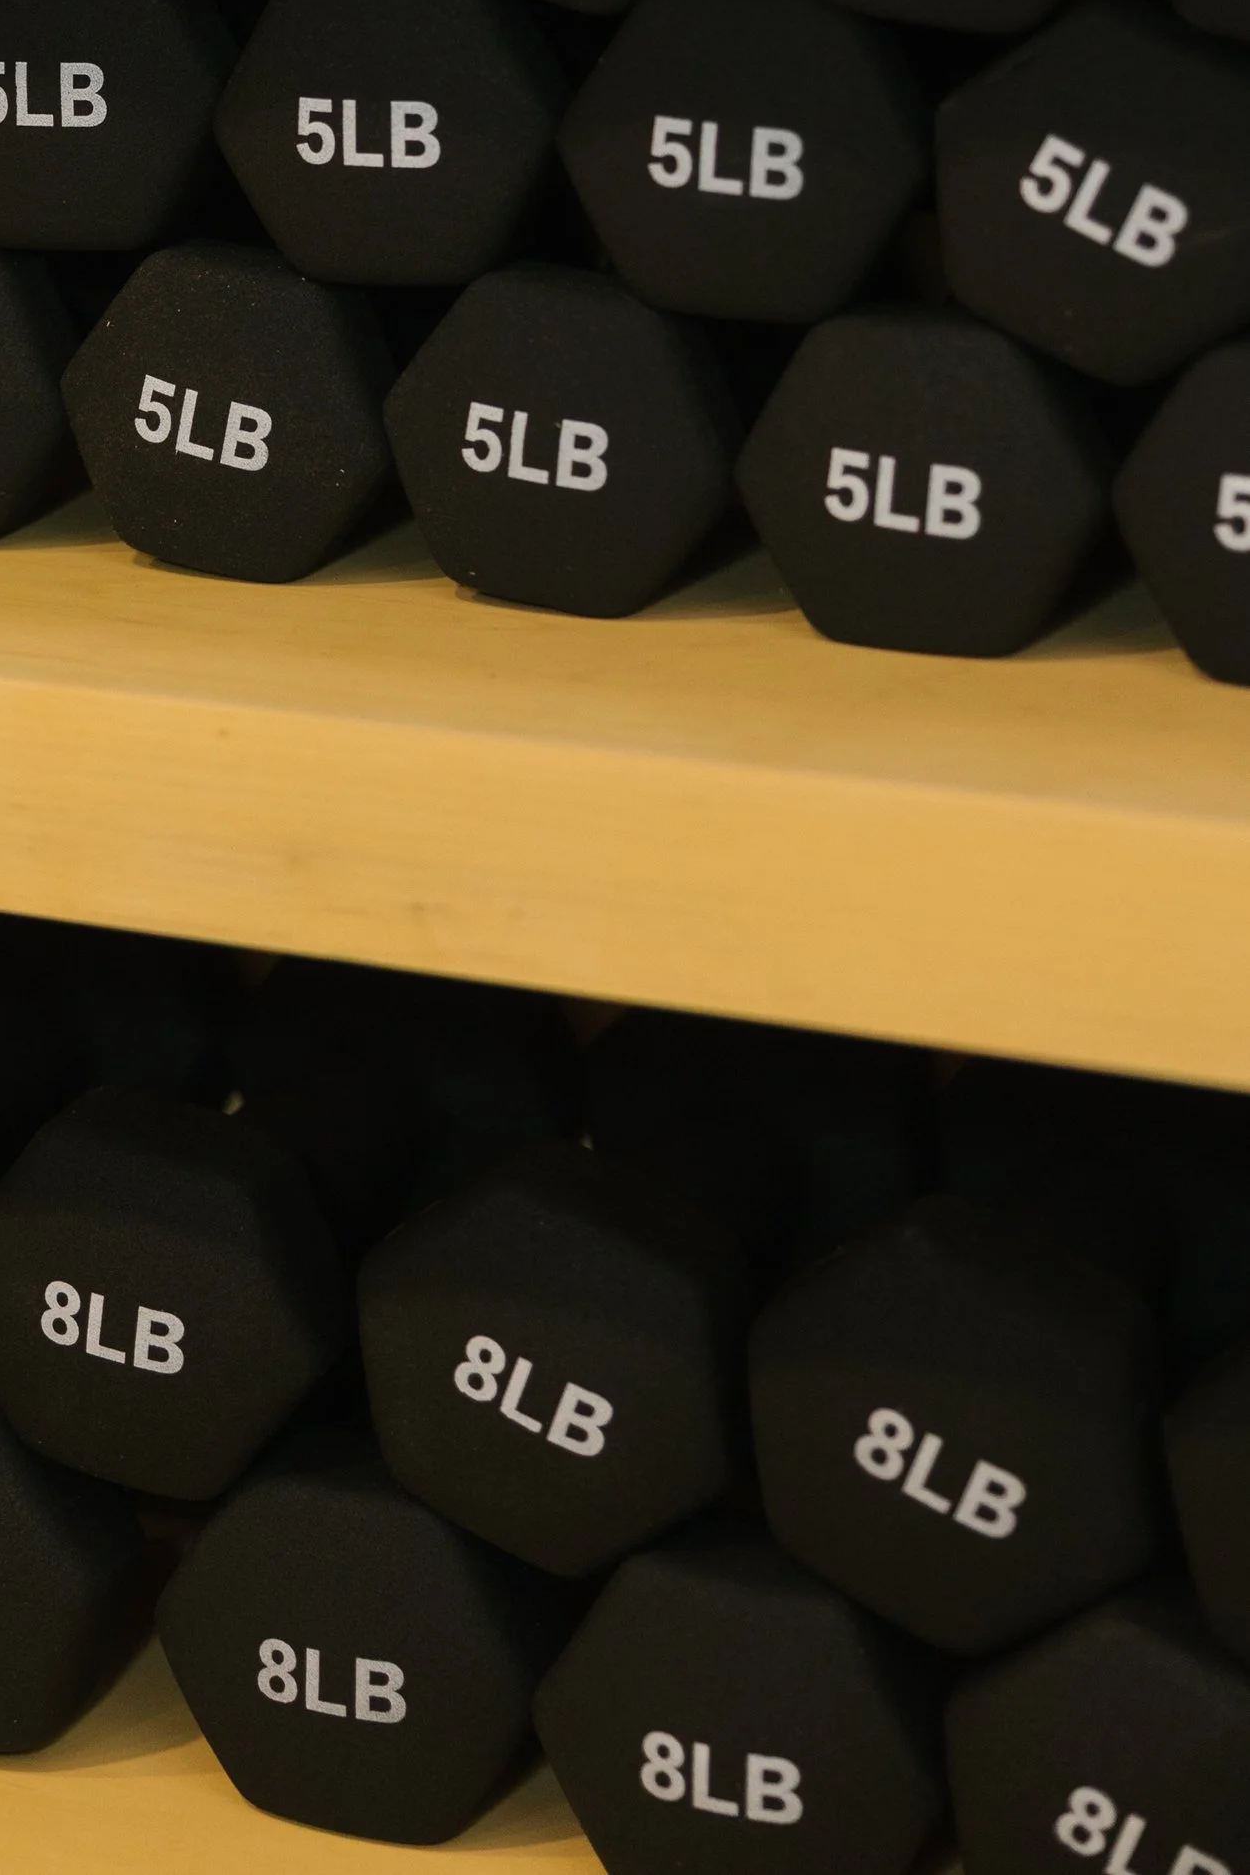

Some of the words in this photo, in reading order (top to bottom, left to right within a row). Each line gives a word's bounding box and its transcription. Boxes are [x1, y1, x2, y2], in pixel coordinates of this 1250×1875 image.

[295, 95, 442, 170] 5LB
[646, 114, 805, 201] 5LB
[1019, 134, 1189, 268] 5LB
[133, 372, 274, 473] 5LB
[460, 400, 610, 493] 5LB
[823, 446, 983, 541] 5LB
[39, 1279, 186, 1375] 8LB
[452, 1334, 614, 1458] 8LB
[854, 1407, 1027, 1539] 8LB
[256, 1637, 408, 1725] 8LB
[639, 1730, 804, 1825] 8LB
